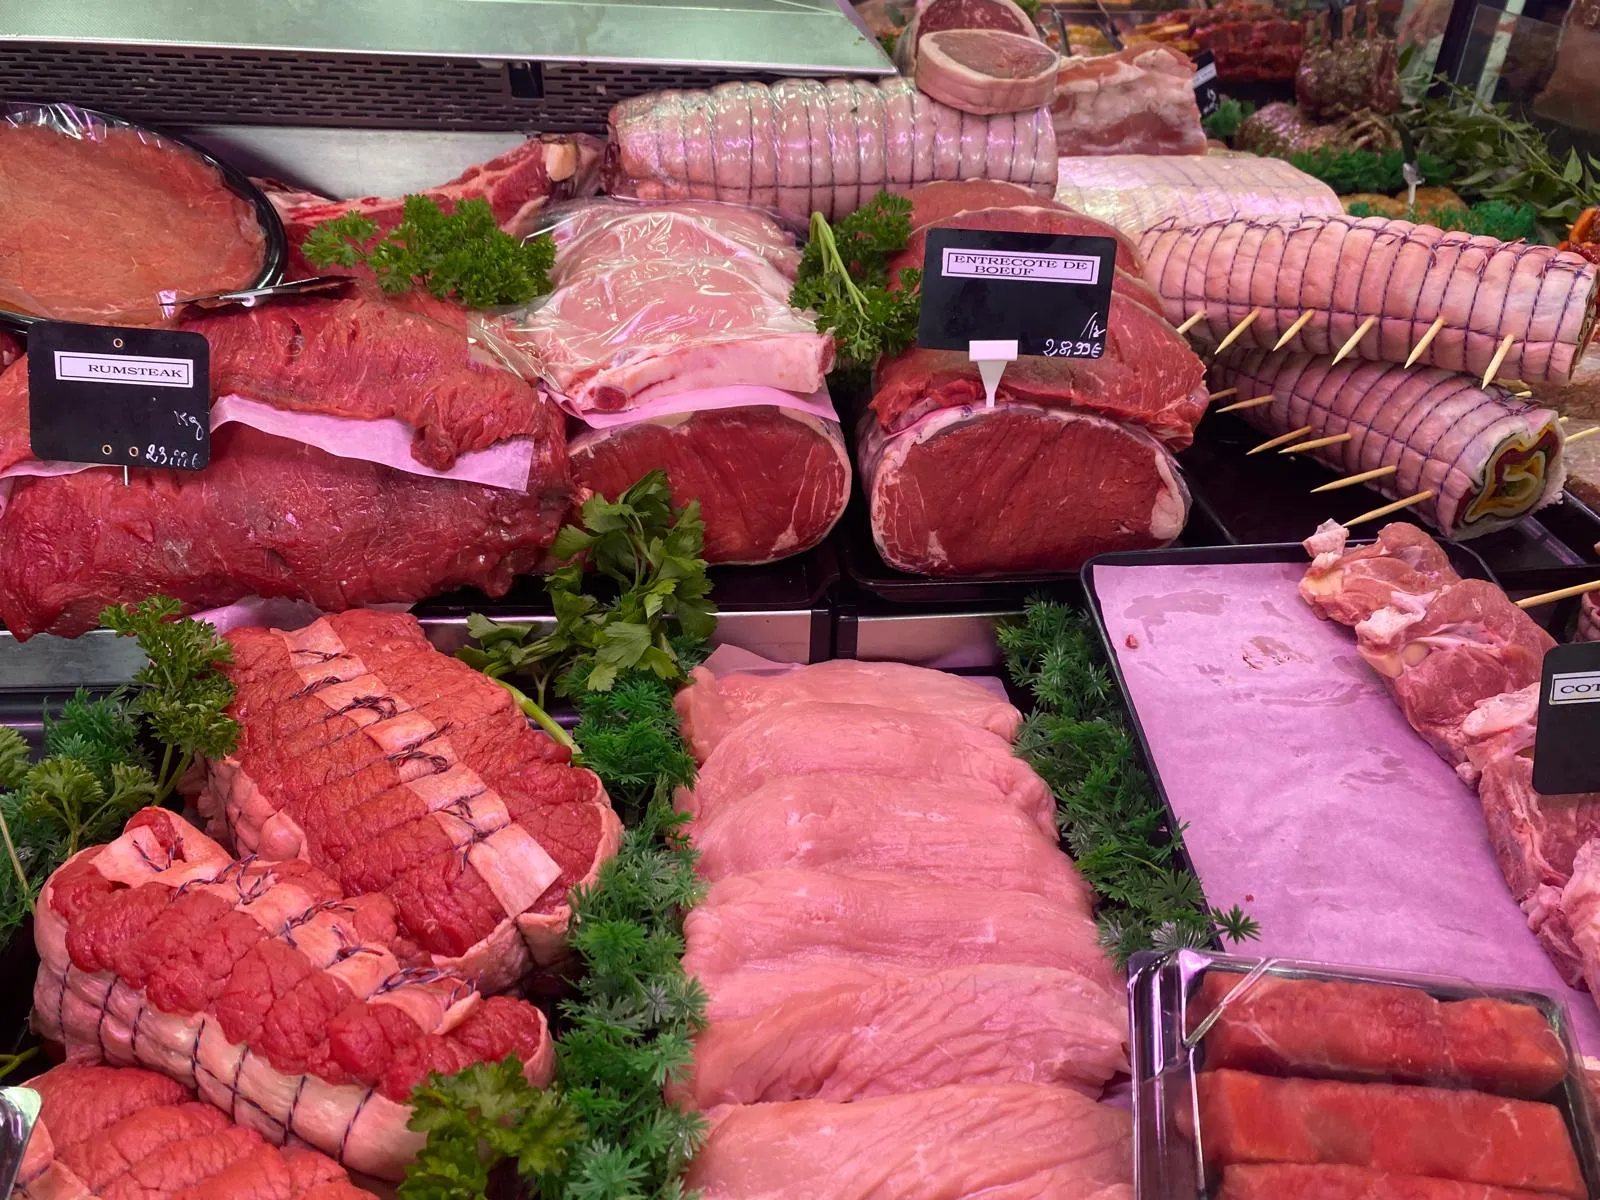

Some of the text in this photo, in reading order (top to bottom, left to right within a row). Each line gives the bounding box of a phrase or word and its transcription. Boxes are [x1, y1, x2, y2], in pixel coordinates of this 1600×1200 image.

[954, 255, 1087, 270] ENTRECOTE DE
[975, 266, 1034, 275] BOEUF
[88, 364, 183, 378] RUMSTEAK
